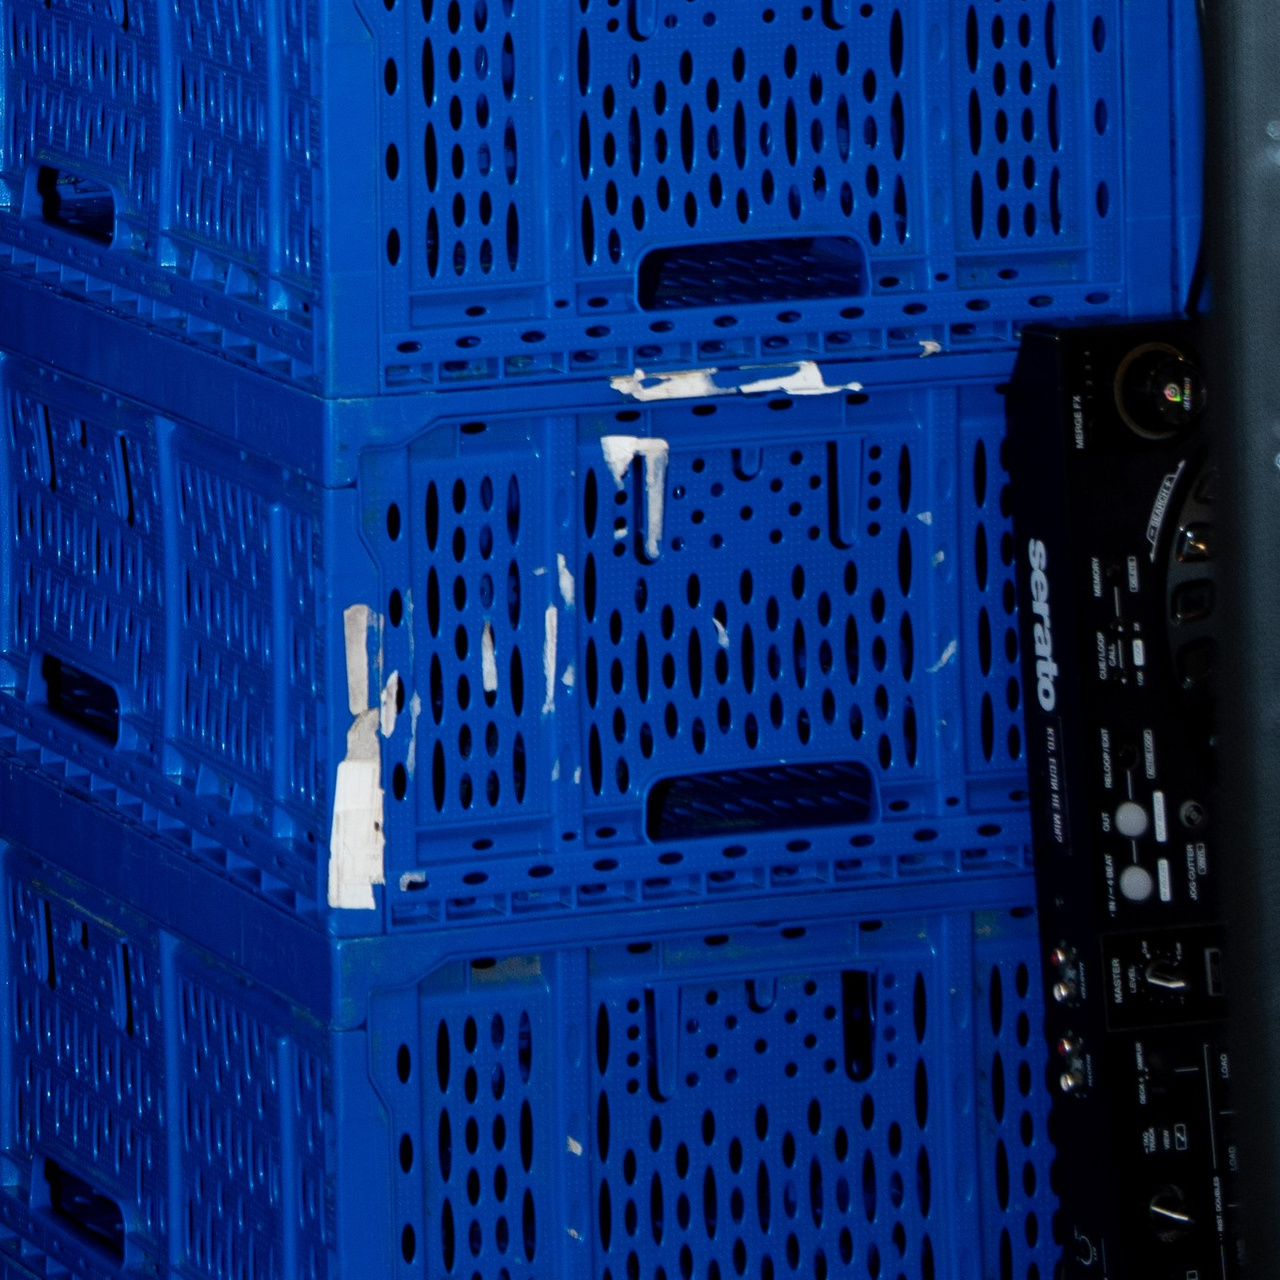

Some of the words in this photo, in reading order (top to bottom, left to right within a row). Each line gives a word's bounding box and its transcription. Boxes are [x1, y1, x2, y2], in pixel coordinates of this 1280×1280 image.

[1071, 394, 1083, 409] FX
[1072, 411, 1085, 449] MERGE
[1090, 556, 1103, 598] MEMORY
[1027, 536, 1059, 712] serato
[1096, 630, 1108, 680] CUE/LOOP
[1107, 643, 1117, 667] CALL
[1101, 810, 1111, 832] OUT
[1104, 852, 1114, 879] BEAT
[1110, 957, 1123, 1004] MASTER
[1127, 965, 1137, 994] LEVEL
[1219, 1053, 1229, 1079] LOAD
[1162, 1129, 1171, 1150] VIEW
